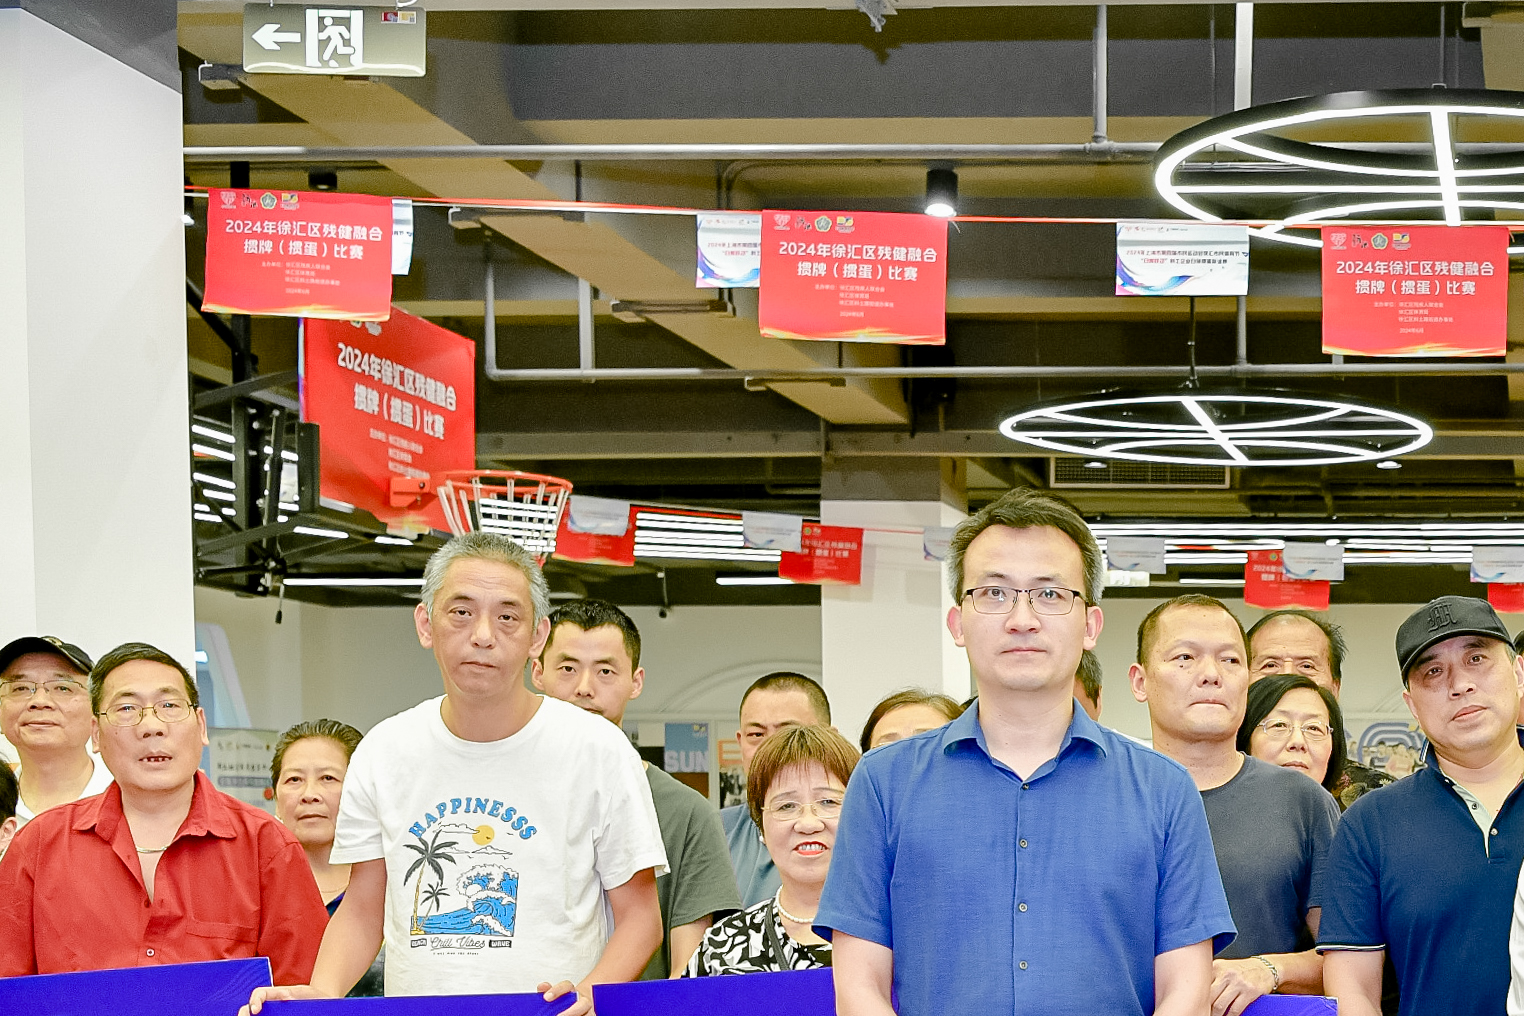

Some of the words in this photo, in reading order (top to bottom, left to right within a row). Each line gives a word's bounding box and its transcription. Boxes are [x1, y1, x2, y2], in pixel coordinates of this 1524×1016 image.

[225, 219, 383, 242] 2024年徐汇区残健融合
[243, 239, 364, 260] 掼牌（掼蛋）比赛
[779, 241, 937, 262] 2024年徐汇区残健融合
[797, 261, 918, 282] 掼牌（掼蛋）比赛
[1336, 261, 1495, 276] 2024年徐汇区残健融合
[1355, 280, 1476, 296] 掼牌（掼蛋）比赛
[337, 342, 457, 412] 2024年徐汇区残健融合
[408, 797, 537, 840] HAPPINESS
